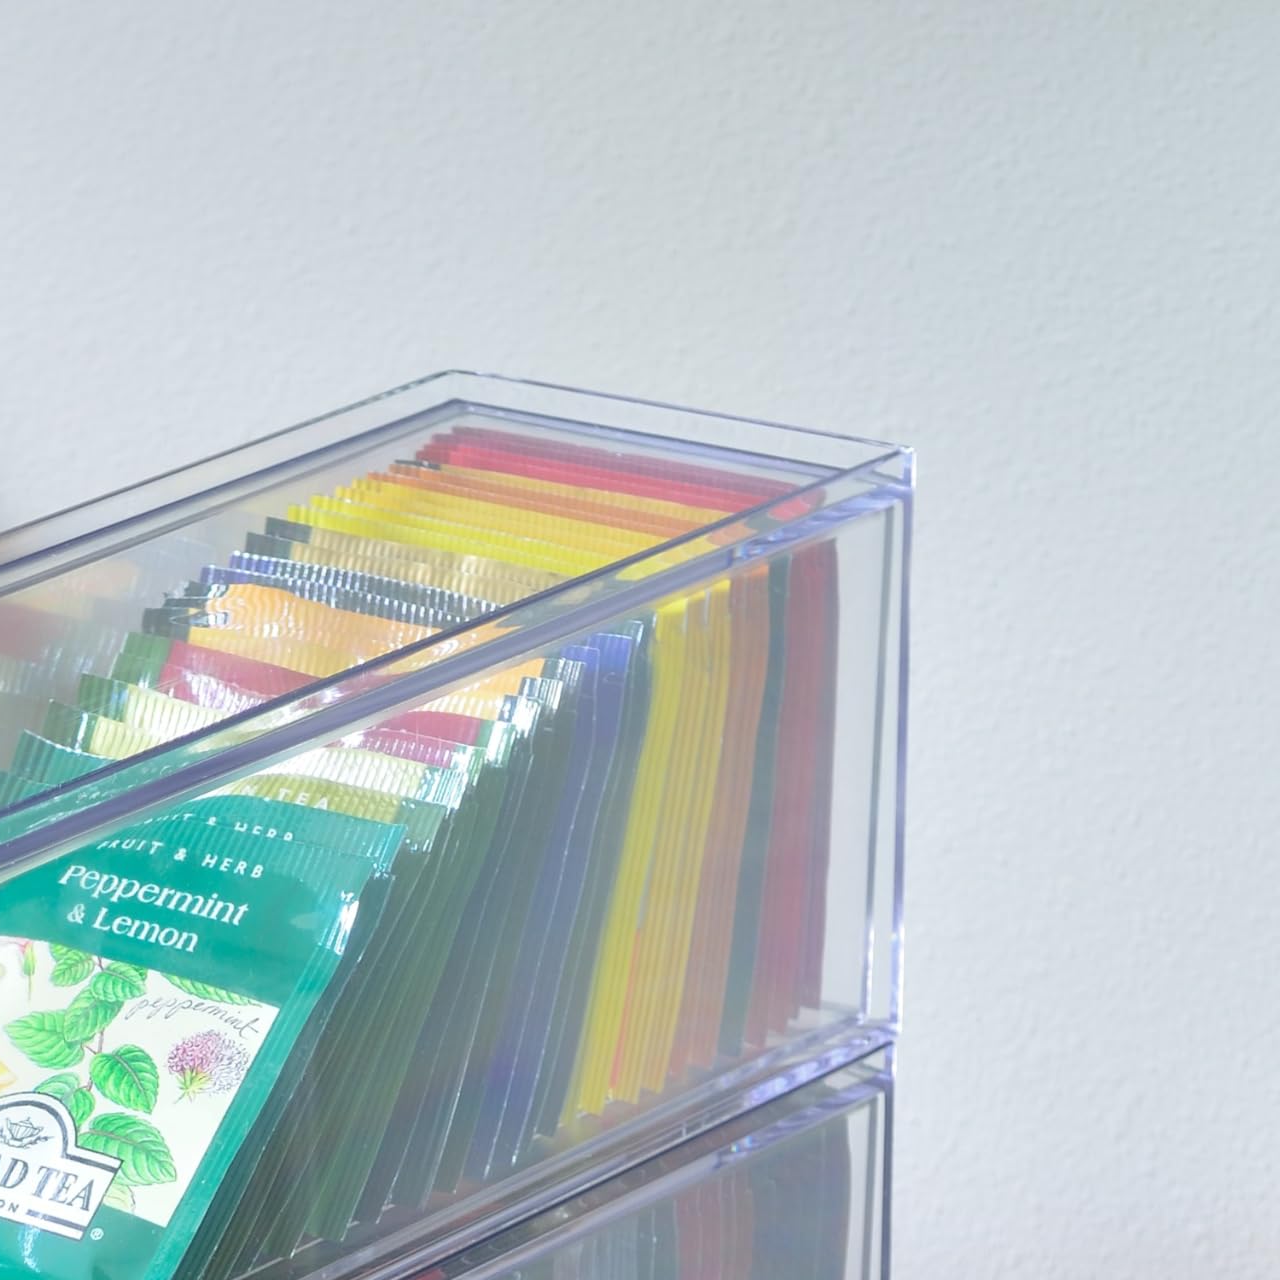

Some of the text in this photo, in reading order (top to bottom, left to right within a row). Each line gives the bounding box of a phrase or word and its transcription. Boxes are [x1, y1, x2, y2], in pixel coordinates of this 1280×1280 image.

[174, 848, 188, 862] &
[202, 853, 264, 878] HERB
[58, 865, 250, 926] Peppermint
[67, 903, 200, 952] & Lemon
[124, 997, 260, 1040] peppermint
[32, 1165, 98, 1212] TEA
